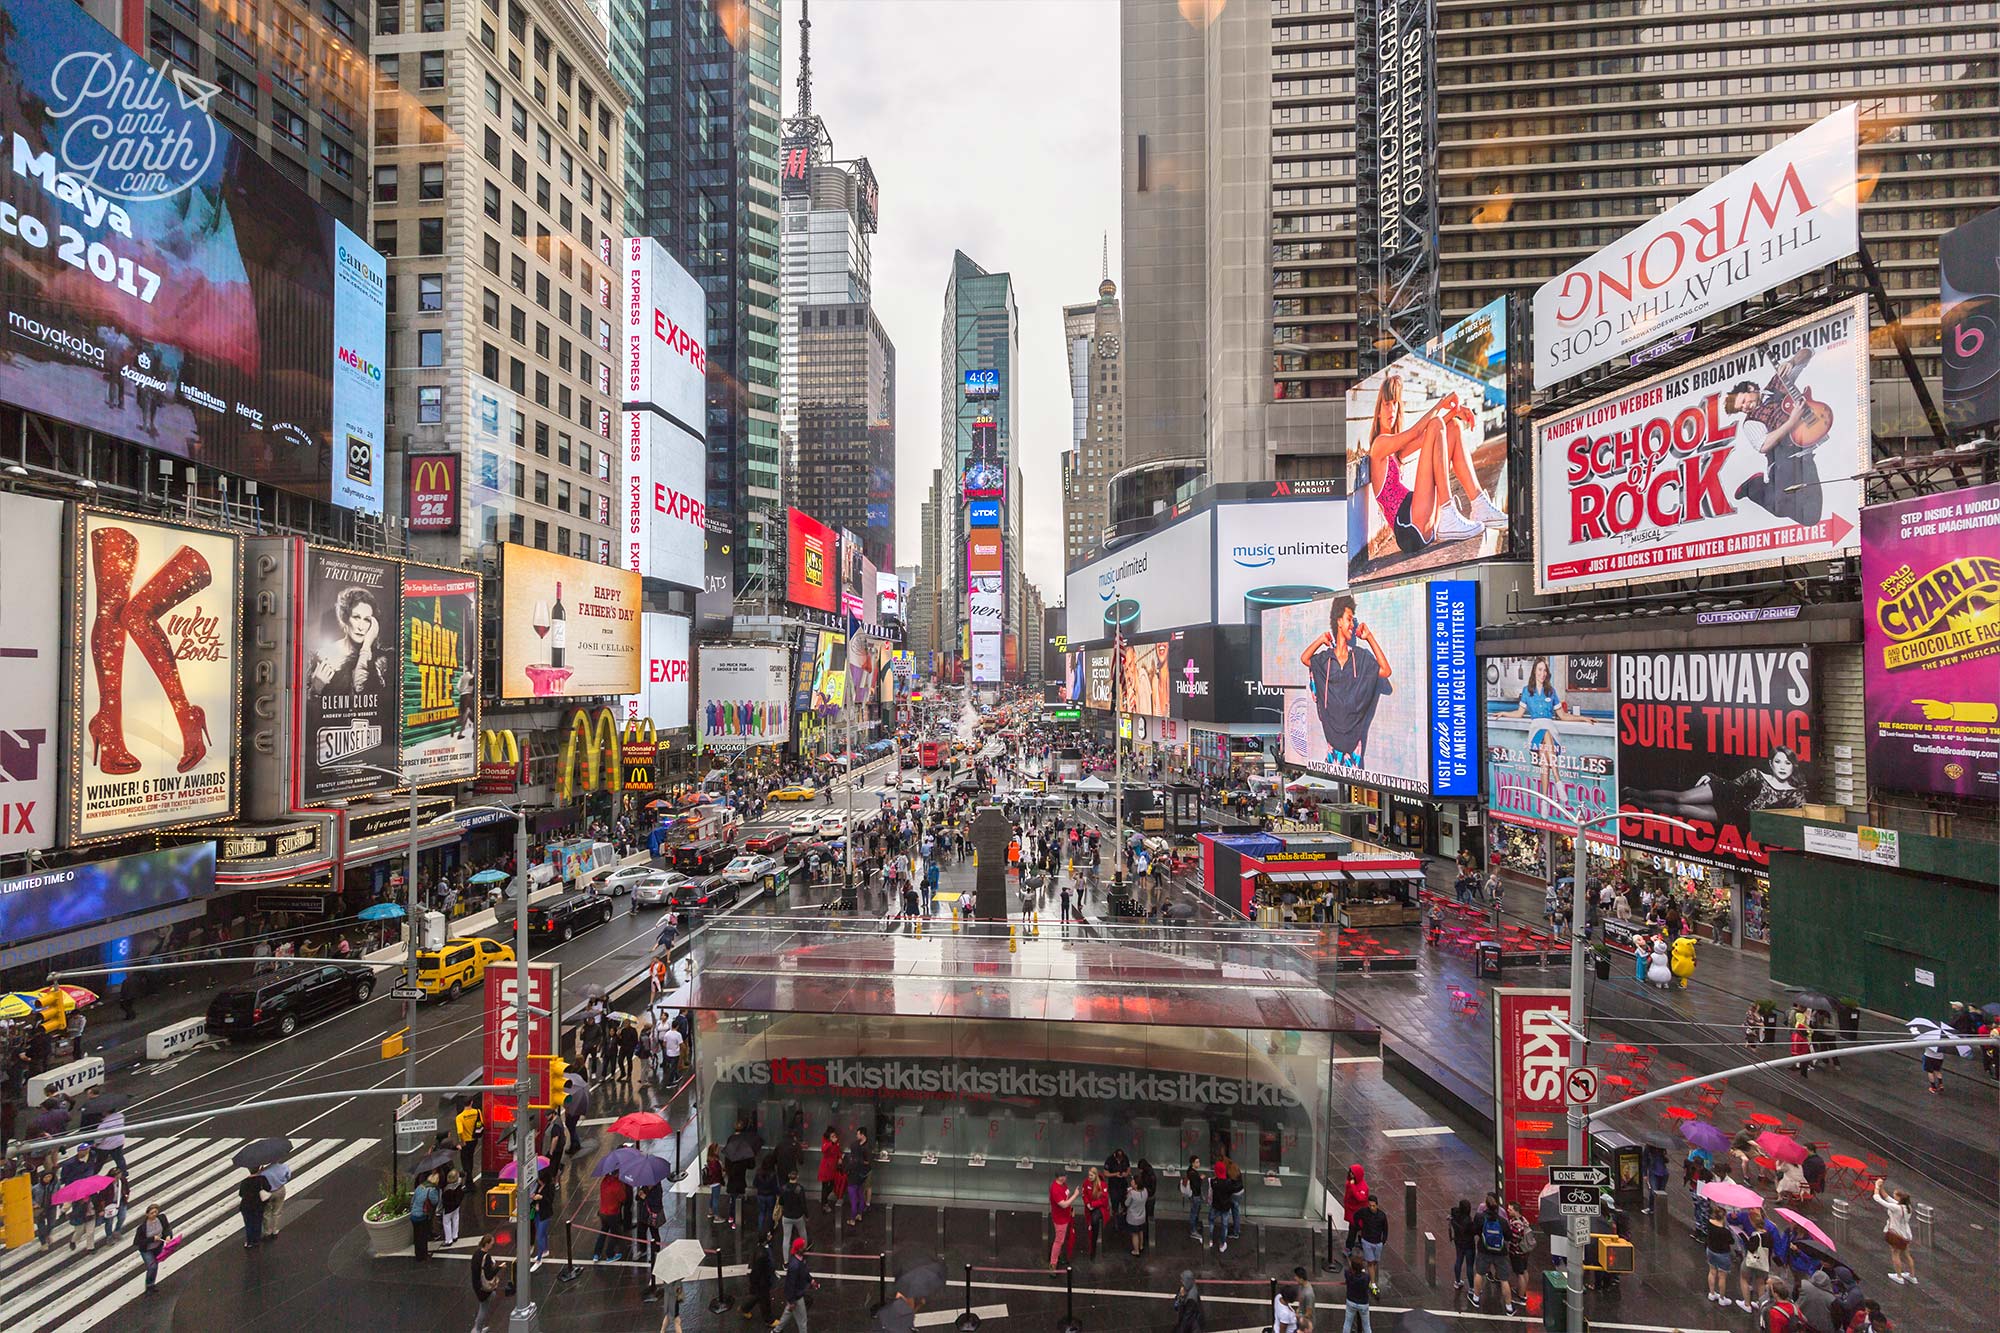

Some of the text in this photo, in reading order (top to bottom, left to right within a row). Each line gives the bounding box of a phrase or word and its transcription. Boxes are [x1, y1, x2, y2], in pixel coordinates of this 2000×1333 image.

[1380, 2, 1399, 250] AMERICAN EAGLE
[1403, 27, 1422, 207] OUTFITTERS
[13, 132, 133, 239] Maya
[1556, 161, 1817, 323] WRONG
[58, 225, 161, 304] 2017
[631, 270, 640, 326] EXPRESS
[1550, 219, 1821, 368] THE PLAY THAT GOES
[9, 311, 105, 360] mayakoba
[631, 336, 640, 391] EXPRESS
[970, 372, 994, 383] 4:02
[1586, 405, 1617, 430] LLOYD
[1619, 387, 1663, 417] WEBBER
[1665, 376, 1689, 401] HAS
[1692, 351, 1766, 392] BROADWAY
[180, 382, 226, 409] infinitum
[236, 402, 263, 422] Hertz
[1567, 391, 1740, 483] SCHOOL
[1627, 452, 1660, 493] of
[417, 494, 448, 502] OPEN
[420, 503, 445, 516] 24
[631, 476, 640, 534] EXPRESS
[1567, 447, 1739, 545] ROCK
[413, 517, 452, 525] HOURS
[978, 509, 997, 517] TDK
[1900, 498, 2000, 526] STEP INSIDE A WORLD
[1901, 513, 2000, 540] OF PURE IMAGINATION
[1233, 543, 1275, 557] music
[1589, 558, 1609, 572] JUST
[1610, 558, 1616, 569] 4
[1617, 551, 1651, 568] BLOCKS
[1651, 550, 1664, 563] TO
[1666, 547, 1683, 561] THE
[1685, 541, 1725, 558] WINTER
[1727, 528, 1770, 551] GARDEN
[1773, 523, 1826, 544] THEATRE
[1115, 552, 1148, 582] unlimited
[1879, 563, 1912, 590] ROALD
[594, 586, 622, 602] HAPPY
[704, 575, 727, 594] CATS
[434, 596, 442, 624] A
[578, 602, 635, 622] FATHER'S DAY
[1436, 589, 1449, 620] LEVEL
[1699, 607, 1798, 623] OUTFRONT PRIME
[254, 554, 278, 755] PALACE
[411, 617, 459, 668] BRONX
[577, 641, 635, 653] JOSH CELLARS
[1437, 641, 1450, 661] THE
[1901, 628, 1973, 661] CHOCOLATE
[1437, 663, 1450, 678] ON
[1570, 655, 1604, 669] 10 Weeks
[1576, 668, 1598, 682] Only!
[1921, 660, 1938, 671] THE
[1940, 656, 1959, 668] NEW
[418, 663, 454, 709] TALE
[1093, 679, 1110, 702] Coke
[1452, 601, 1467, 776] OF AMERICAN EAGLE OUTFITTERS
[1621, 651, 1810, 706] BROADWAY'S
[322, 694, 378, 710] GLENN CLOSE
[1437, 682, 1450, 718] INSIDE
[1620, 703, 1811, 762] SURE THING
[1892, 722, 1923, 731] FACTORY
[1954, 726, 1988, 734] AROUND
[326, 729, 364, 758] SUNSET
[1913, 743, 1998, 759] CharlieOnBroadway.com
[1438, 759, 1451, 789] VISIT
[1493, 747, 1607, 774] SARA BAREILLES
[86, 771, 226, 800] WINNER! 6 TONY AWARDS
[1306, 761, 1429, 795] AMERICAN EAGLE OUTFITTERS
[86, 786, 226, 811] INCLUDING BEST MUSICAL
[471, 812, 496, 825] MONEY
[228, 840, 252, 855] SUNSET
[281, 834, 305, 853] SUNSET
[1732, 846, 1762, 857] MUSICAL
[1653, 855, 1705, 880] SLAM
[3, 877, 42, 893] LIMITED
[43, 873, 64, 887] TIME
[169, 1024, 205, 1047] NYPD
[51, 1066, 96, 1093] NYPD
[1558, 1172, 1601, 1180] ONE WAY
[1563, 1205, 1577, 1213] BIKE
